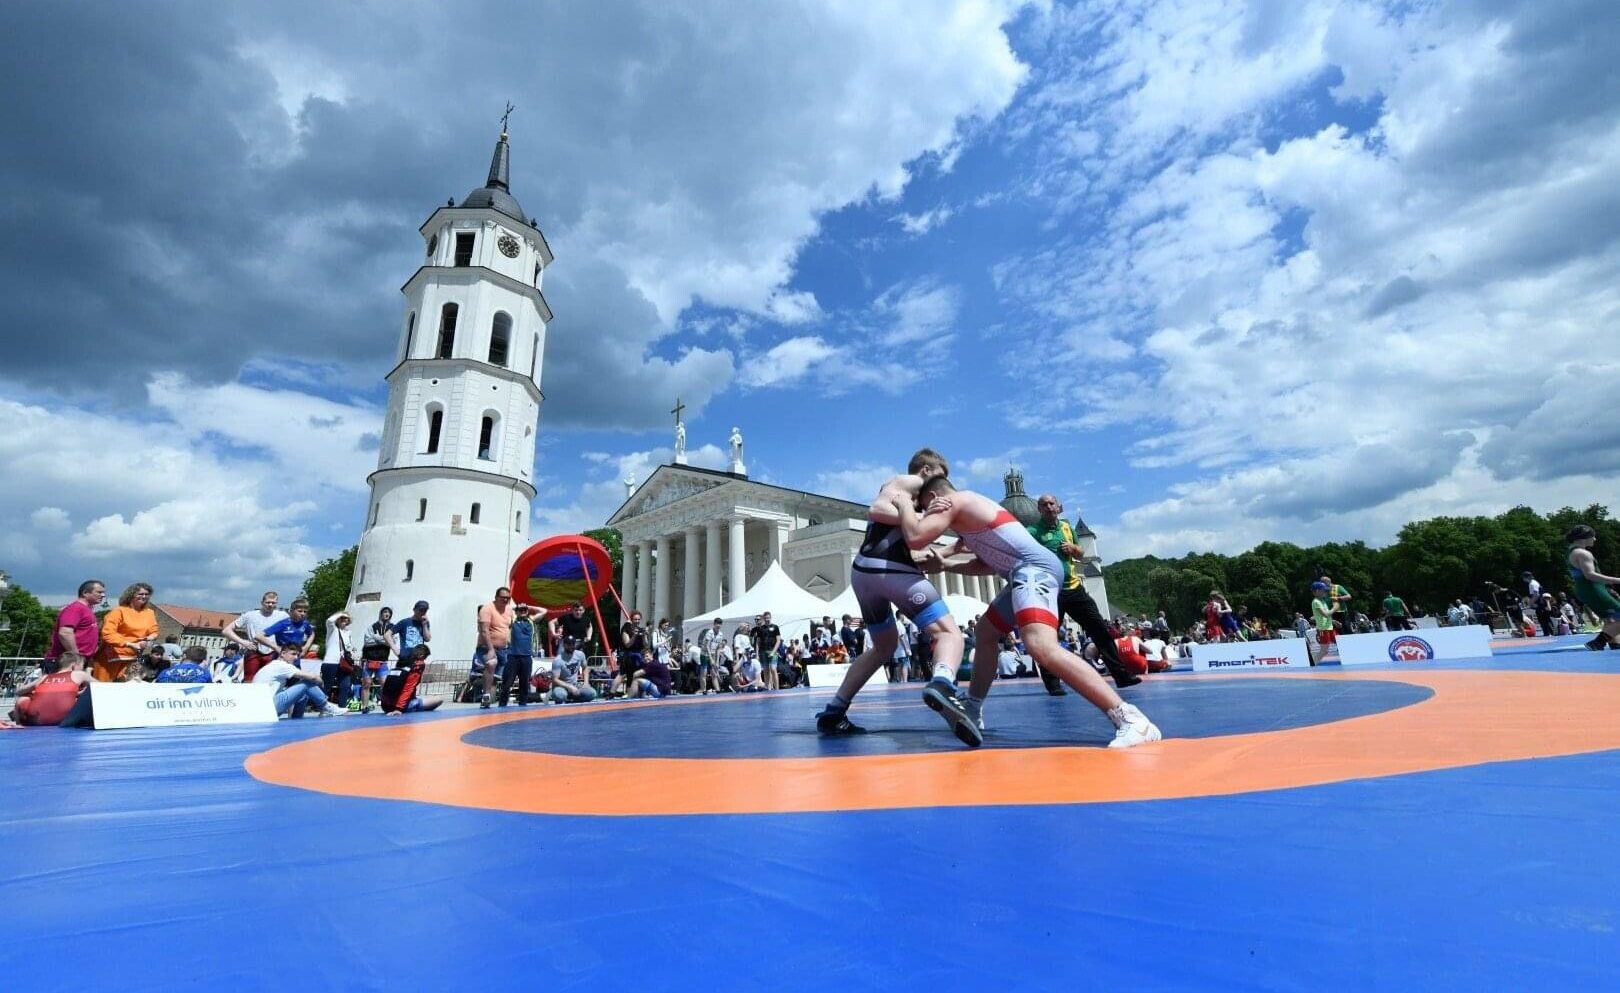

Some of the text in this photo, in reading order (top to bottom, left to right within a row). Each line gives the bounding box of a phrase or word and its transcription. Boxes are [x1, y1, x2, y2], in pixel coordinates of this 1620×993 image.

[146, 697, 237, 709] air inn vilnius
